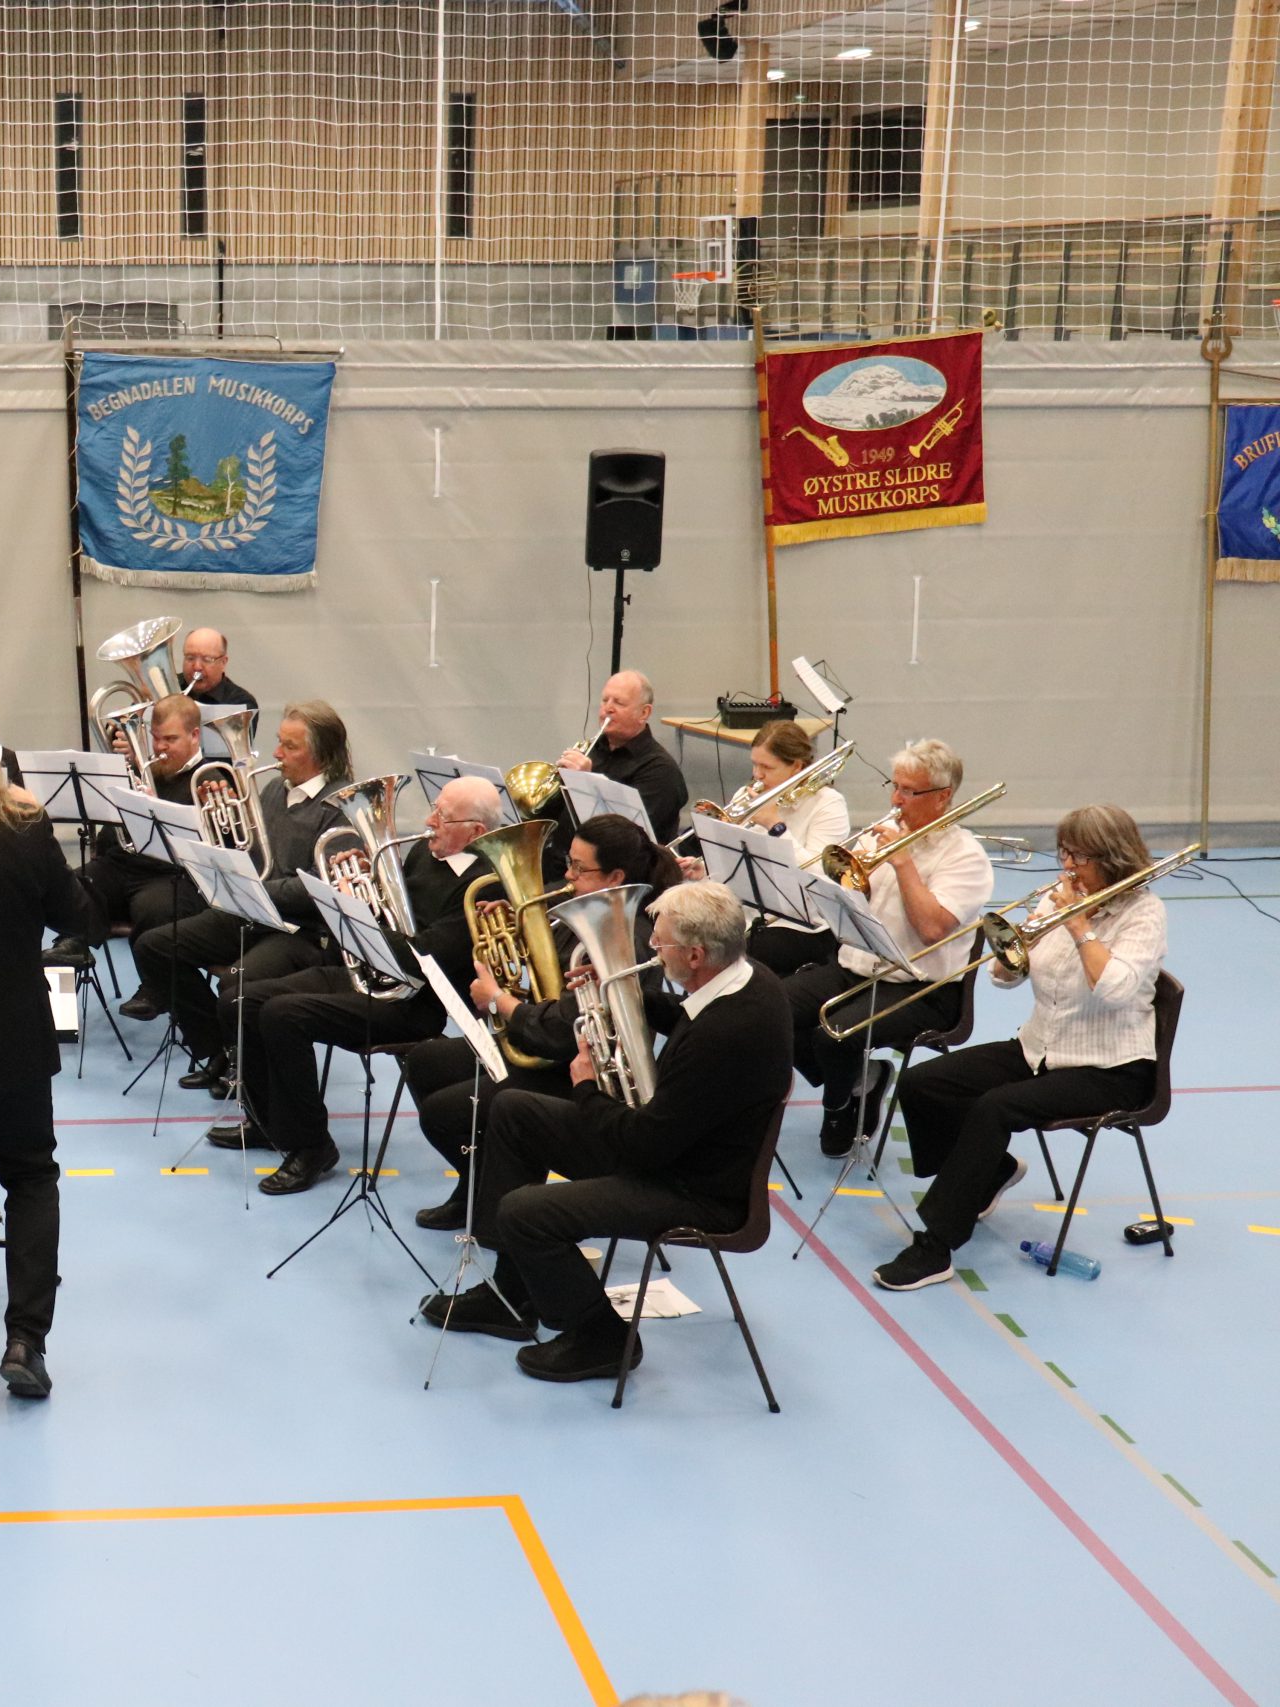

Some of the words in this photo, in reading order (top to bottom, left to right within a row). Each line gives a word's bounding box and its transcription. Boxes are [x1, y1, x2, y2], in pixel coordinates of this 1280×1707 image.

[87, 376, 196, 421] BEGNADALEN
[208, 375, 314, 435] MUSIKKORPS
[862, 447, 895, 465] 1949
[803, 470, 881, 497] ØYSTRE
[885, 462, 953, 485] SLIDRE
[816, 485, 940, 516] MUSIKKORPS
